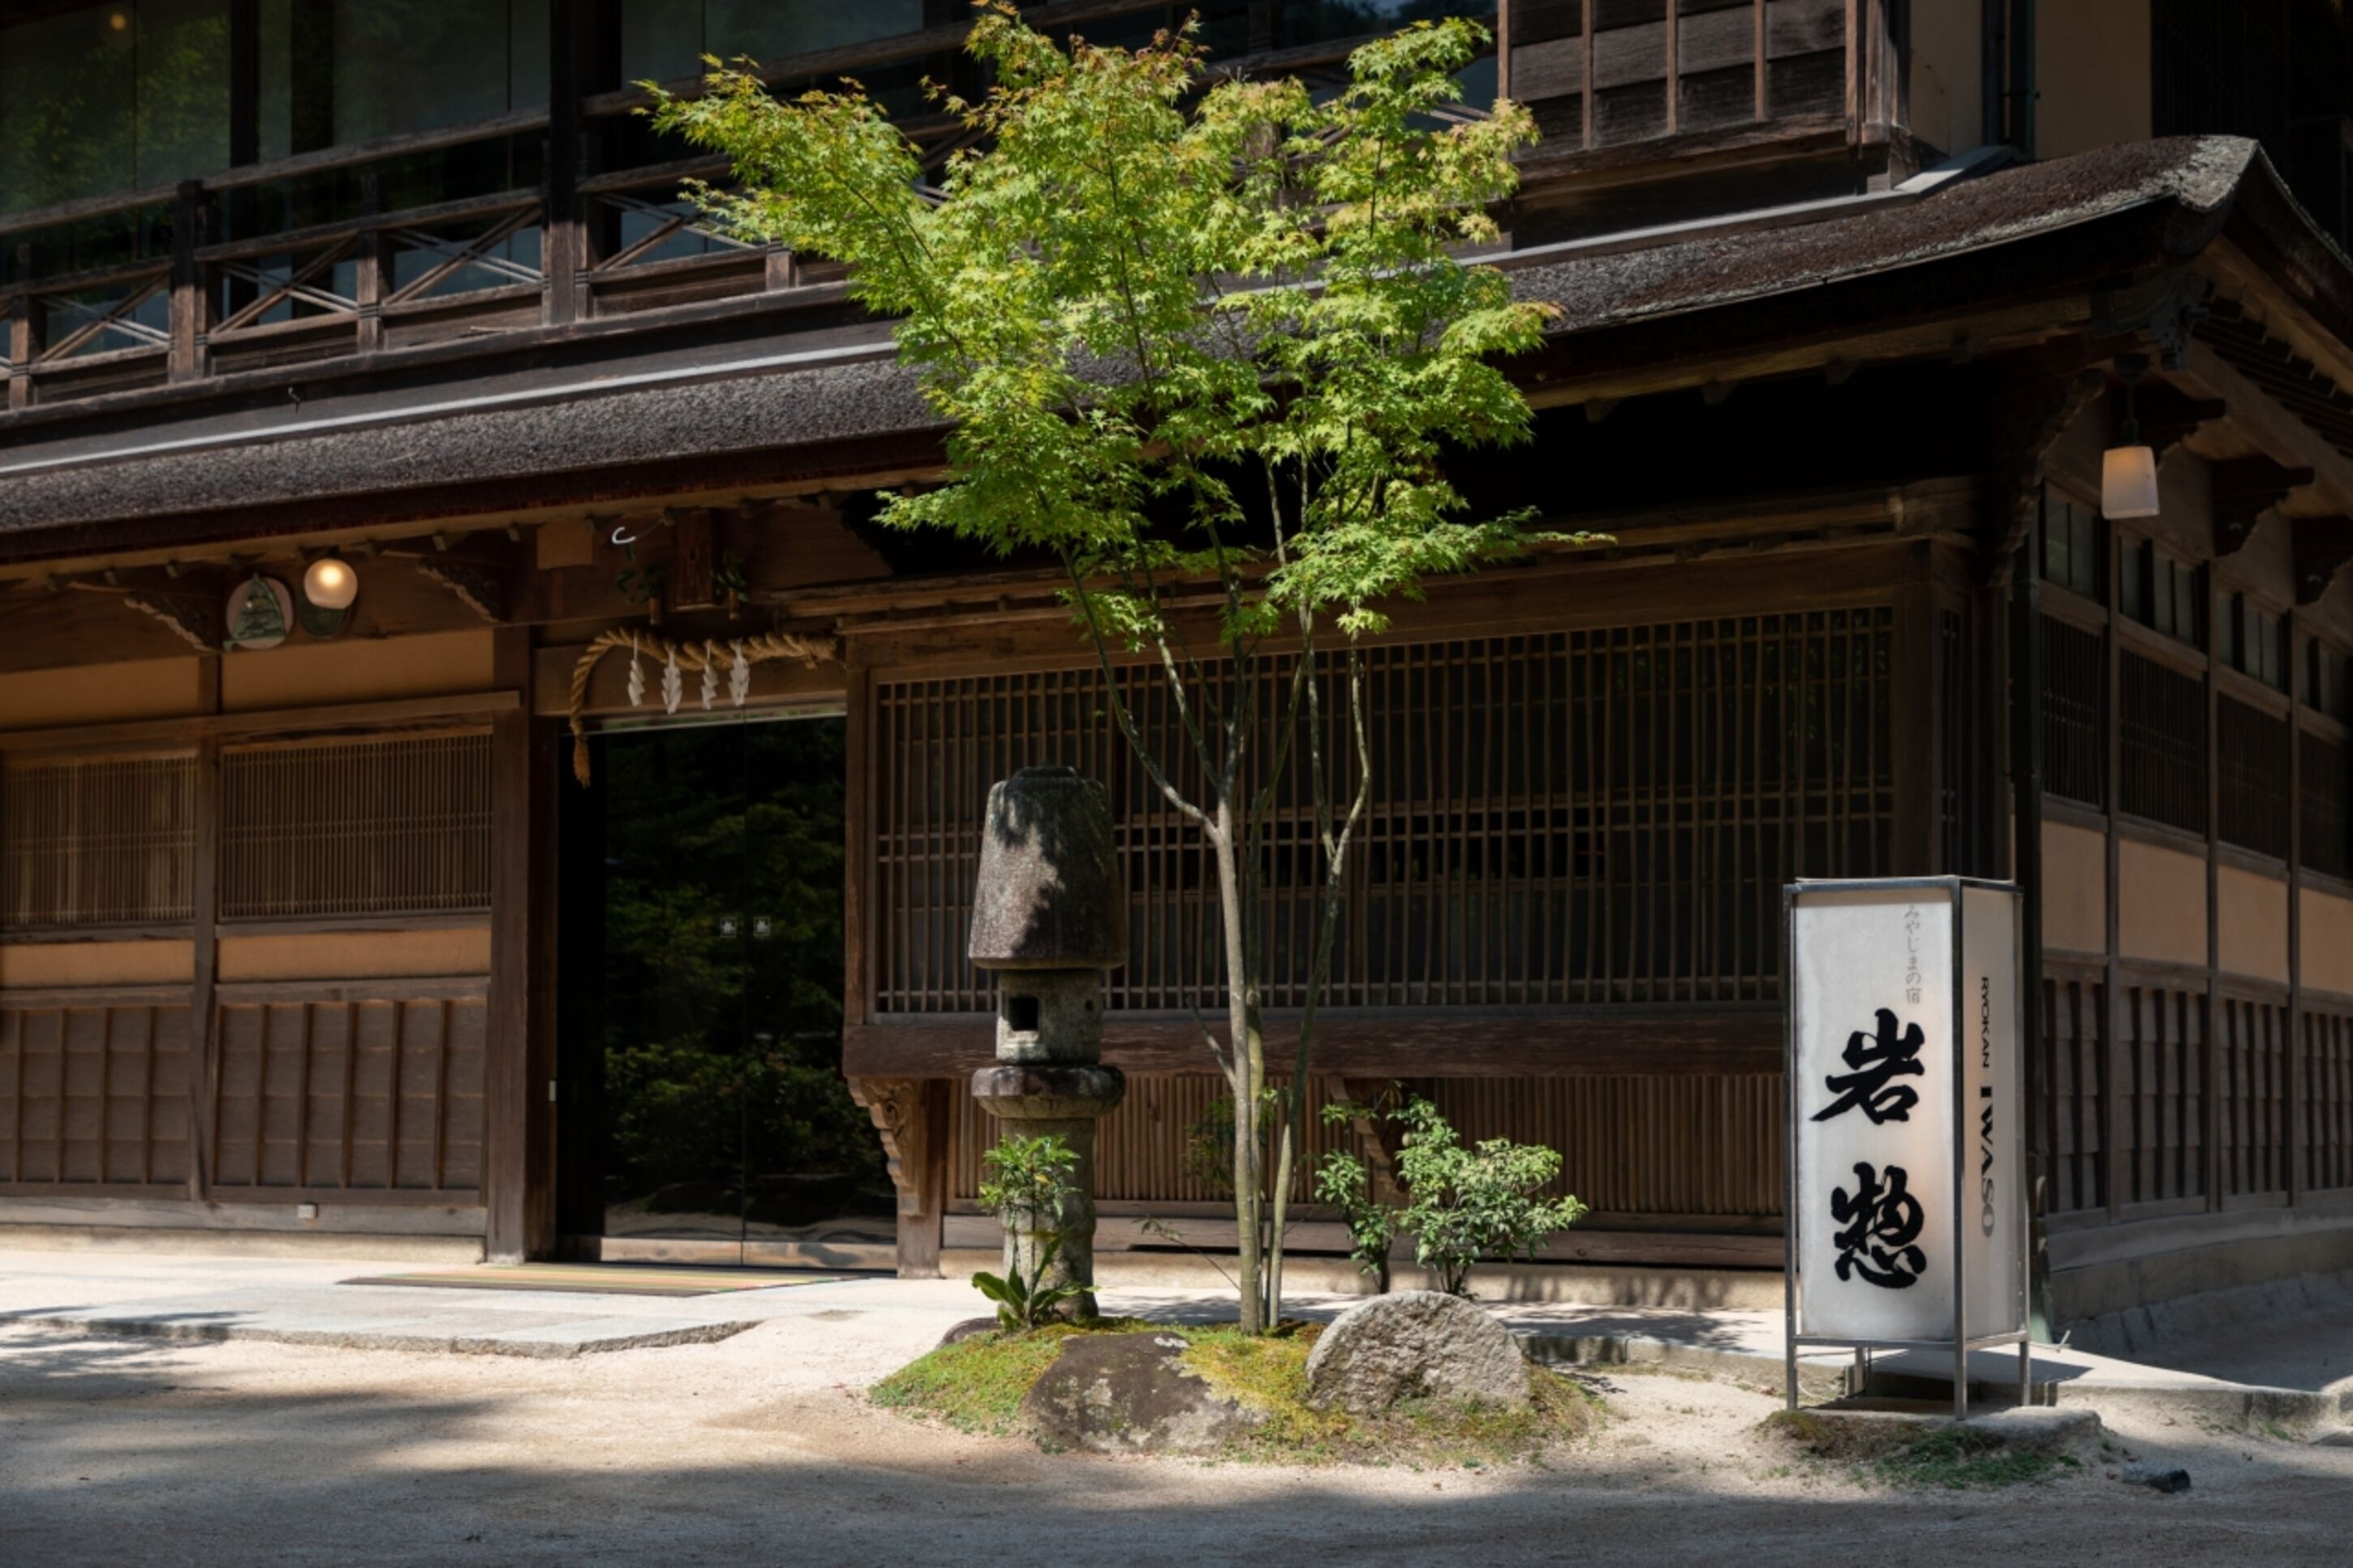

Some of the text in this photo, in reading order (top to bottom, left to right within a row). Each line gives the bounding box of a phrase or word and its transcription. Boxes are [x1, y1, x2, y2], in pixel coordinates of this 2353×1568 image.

[1903, 904, 1923, 1005] みやじまの宿
[1810, 1007, 1928, 1291] 岩惣
[1980, 976, 1995, 1238] RYOKAN IWASO
